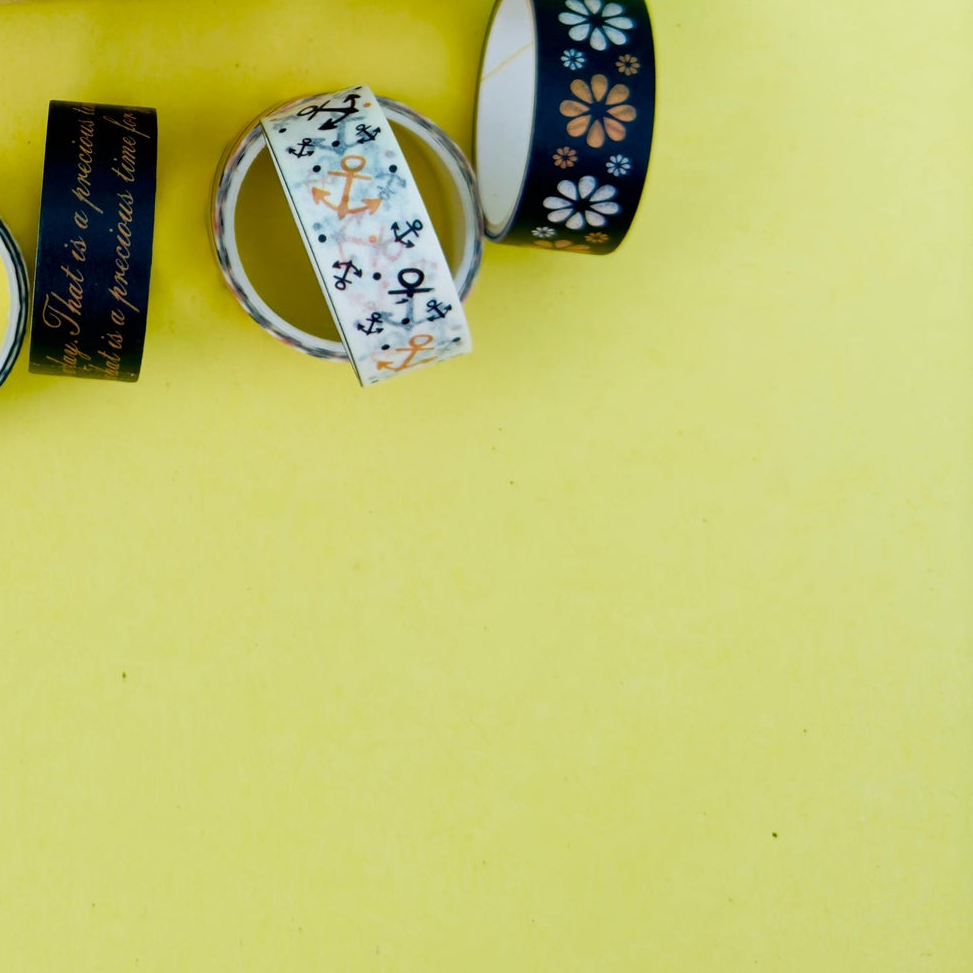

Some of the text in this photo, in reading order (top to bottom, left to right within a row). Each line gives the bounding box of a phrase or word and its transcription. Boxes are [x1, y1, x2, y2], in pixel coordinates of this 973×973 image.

[102, 112, 151, 139] for
[71, 119, 104, 214] precious
[111, 136, 137, 183] time
[74, 210, 89, 230] a
[63, 235, 87, 262] is
[108, 188, 141, 313] precious
[42, 265, 85, 336] That
[110, 309, 126, 327] a
[100, 330, 124, 350] is
